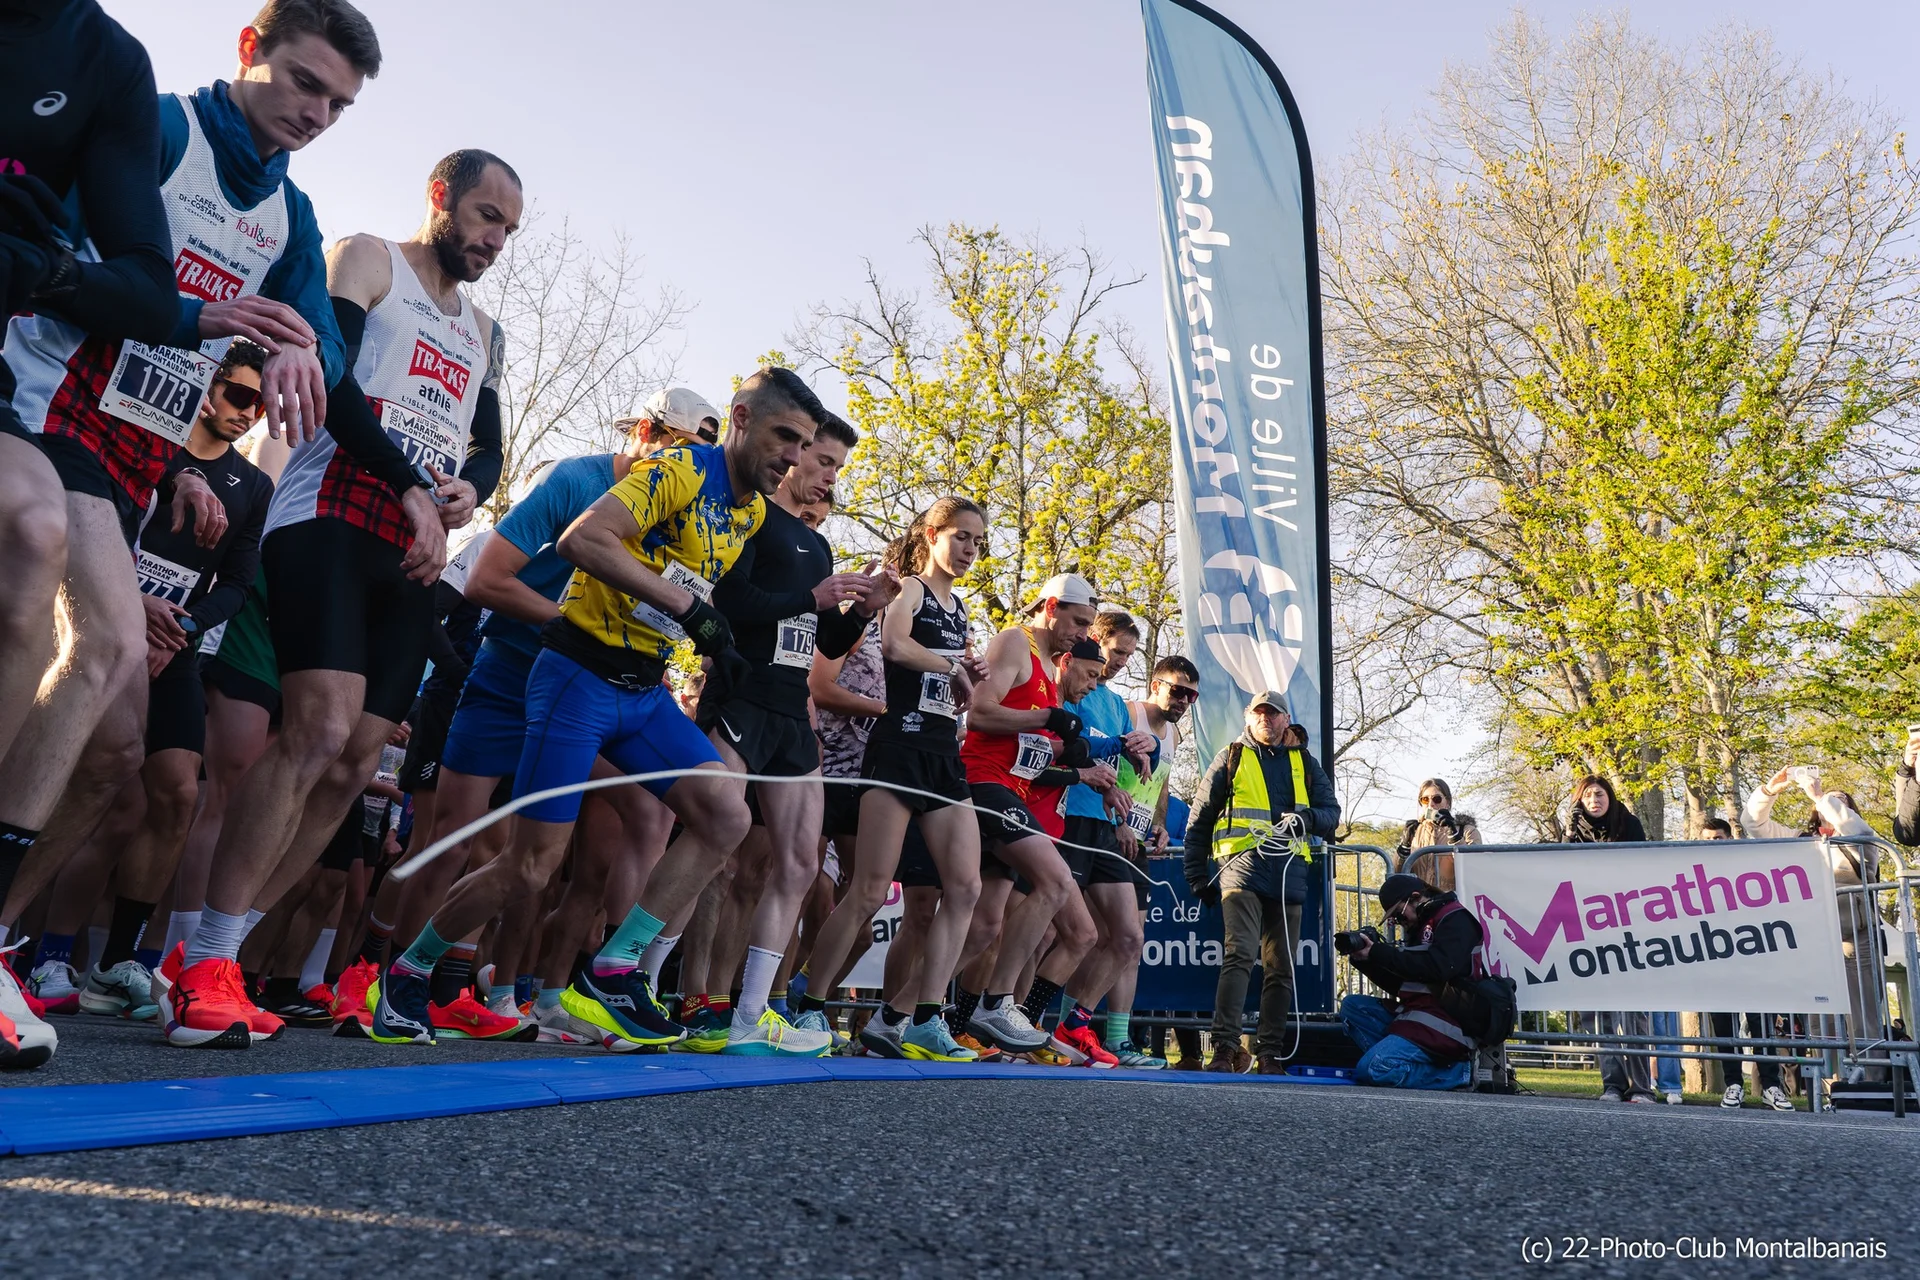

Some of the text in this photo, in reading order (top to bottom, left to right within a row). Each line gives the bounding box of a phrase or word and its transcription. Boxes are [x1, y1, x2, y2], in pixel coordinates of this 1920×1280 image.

[176, 255, 239, 301] TRACKS
[415, 345, 468, 395] TRACKS
[138, 364, 191, 418] 1773
[419, 384, 451, 413] athlé
[398, 410, 449, 446] MARATHON
[401, 436, 446, 473] 1786
[139, 565, 171, 581] NTAUBAN
[793, 629, 815, 655] 179
[1172, 900, 1201, 923] de
[1474, 863, 1813, 978] Marathon
